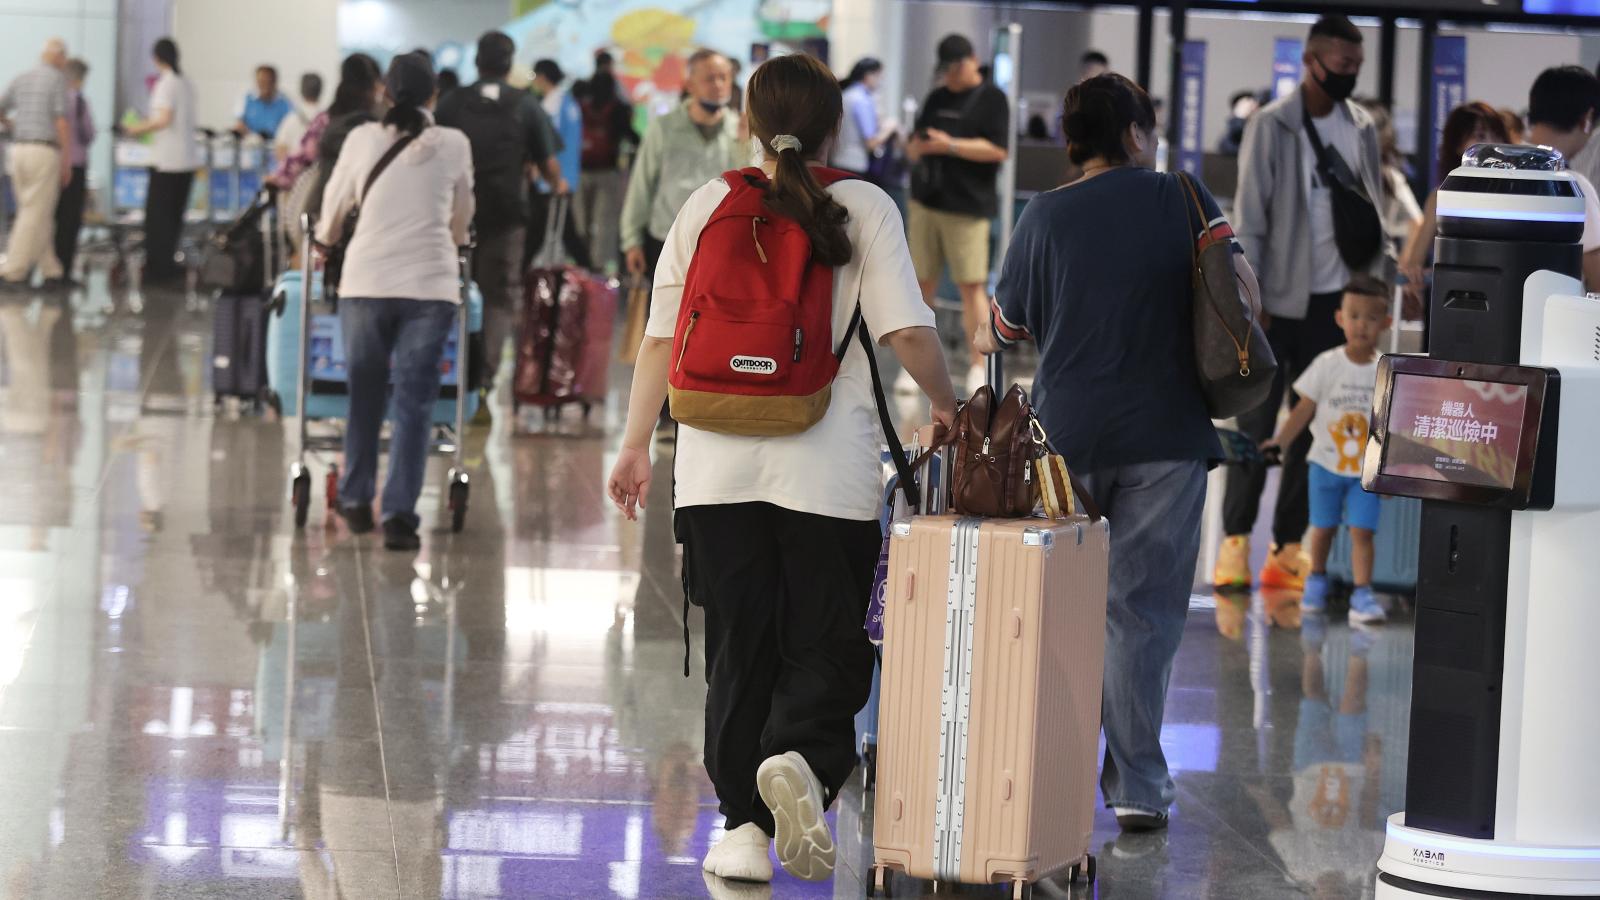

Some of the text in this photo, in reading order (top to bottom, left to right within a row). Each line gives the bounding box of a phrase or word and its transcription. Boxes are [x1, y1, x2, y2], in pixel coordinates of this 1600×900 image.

[733, 359, 772, 370] OUTDOOR
[1441, 400, 1475, 418] 機器人
[1412, 414, 1498, 445] 清潔巡檢中
